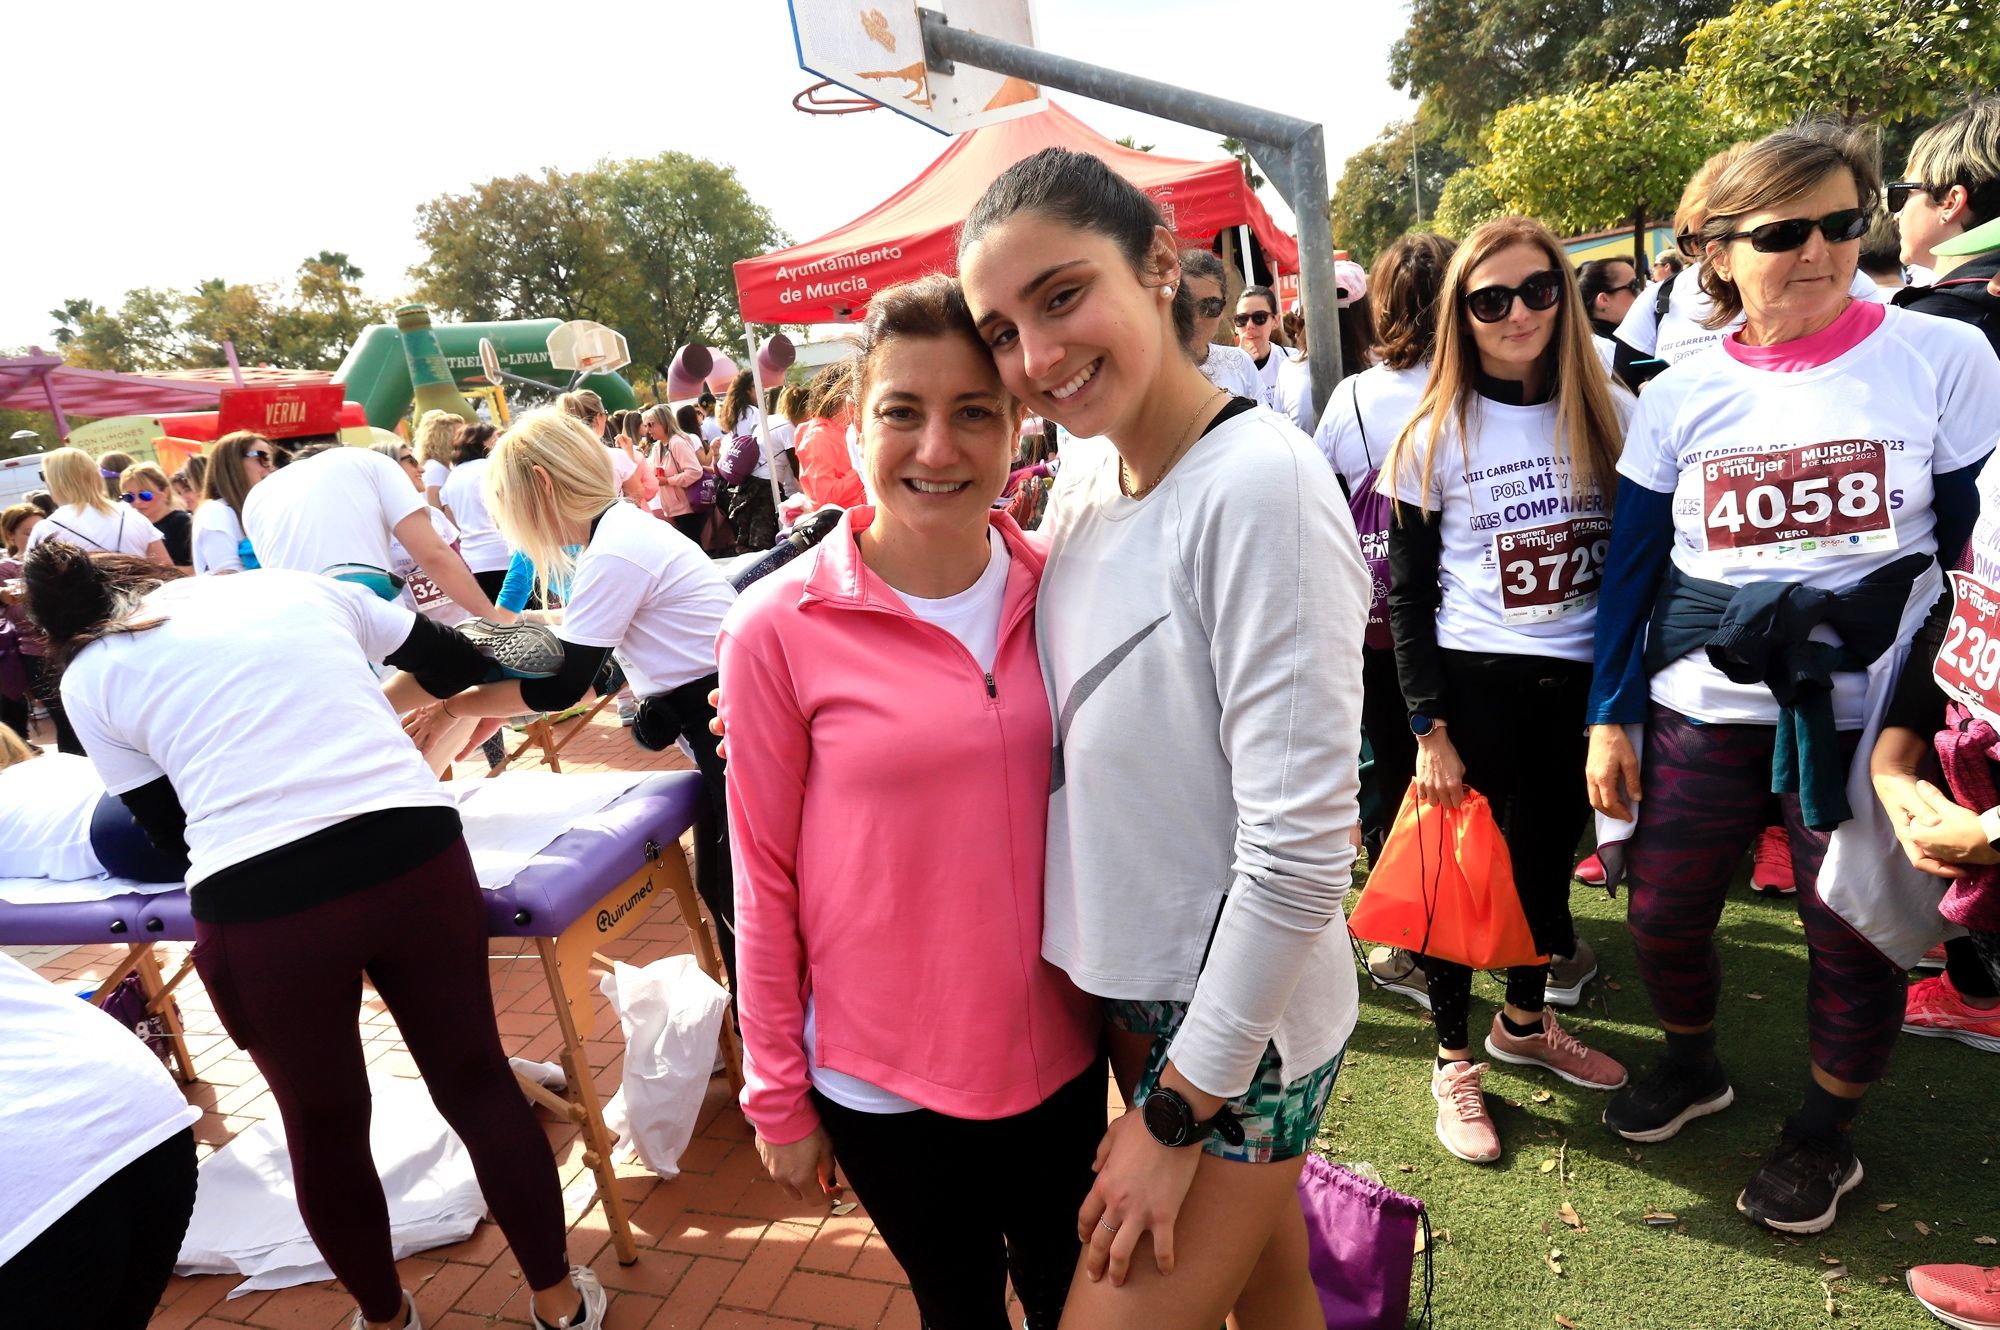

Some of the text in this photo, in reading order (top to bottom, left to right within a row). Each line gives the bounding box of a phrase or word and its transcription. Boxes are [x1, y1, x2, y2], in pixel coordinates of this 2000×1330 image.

[776, 247, 902, 282] Ayuntamiento
[780, 276, 868, 304] de Murcia
[1675, 334, 1718, 348] CARRERA
[265, 401, 307, 426] VERNA
[99, 427, 145, 443] LIMONES
[101, 438, 141, 451] MURCIA
[1720, 456, 1755, 468] carrera
[1801, 441, 1876, 462] MURCIA
[1822, 455, 1854, 465] MARZO
[1855, 451, 1878, 460] 2023
[1486, 459, 1535, 478] CARRERA
[1537, 456, 1551, 467] DE
[1729, 459, 1787, 482] mujer
[1491, 480, 1528, 501] POR
[1528, 467, 1555, 492] MÍ
[1707, 471, 1881, 534] 4058
[1469, 512, 1502, 532] MIS
[1516, 529, 1546, 540] carrera
[1526, 530, 1569, 551] mujer
[1775, 529, 1809, 540] VERO
[1505, 539, 1609, 596] 3729
[1564, 590, 1580, 600] ANA
[1940, 615, 2000, 691] 239
[596, 873, 654, 933] Quirumed
